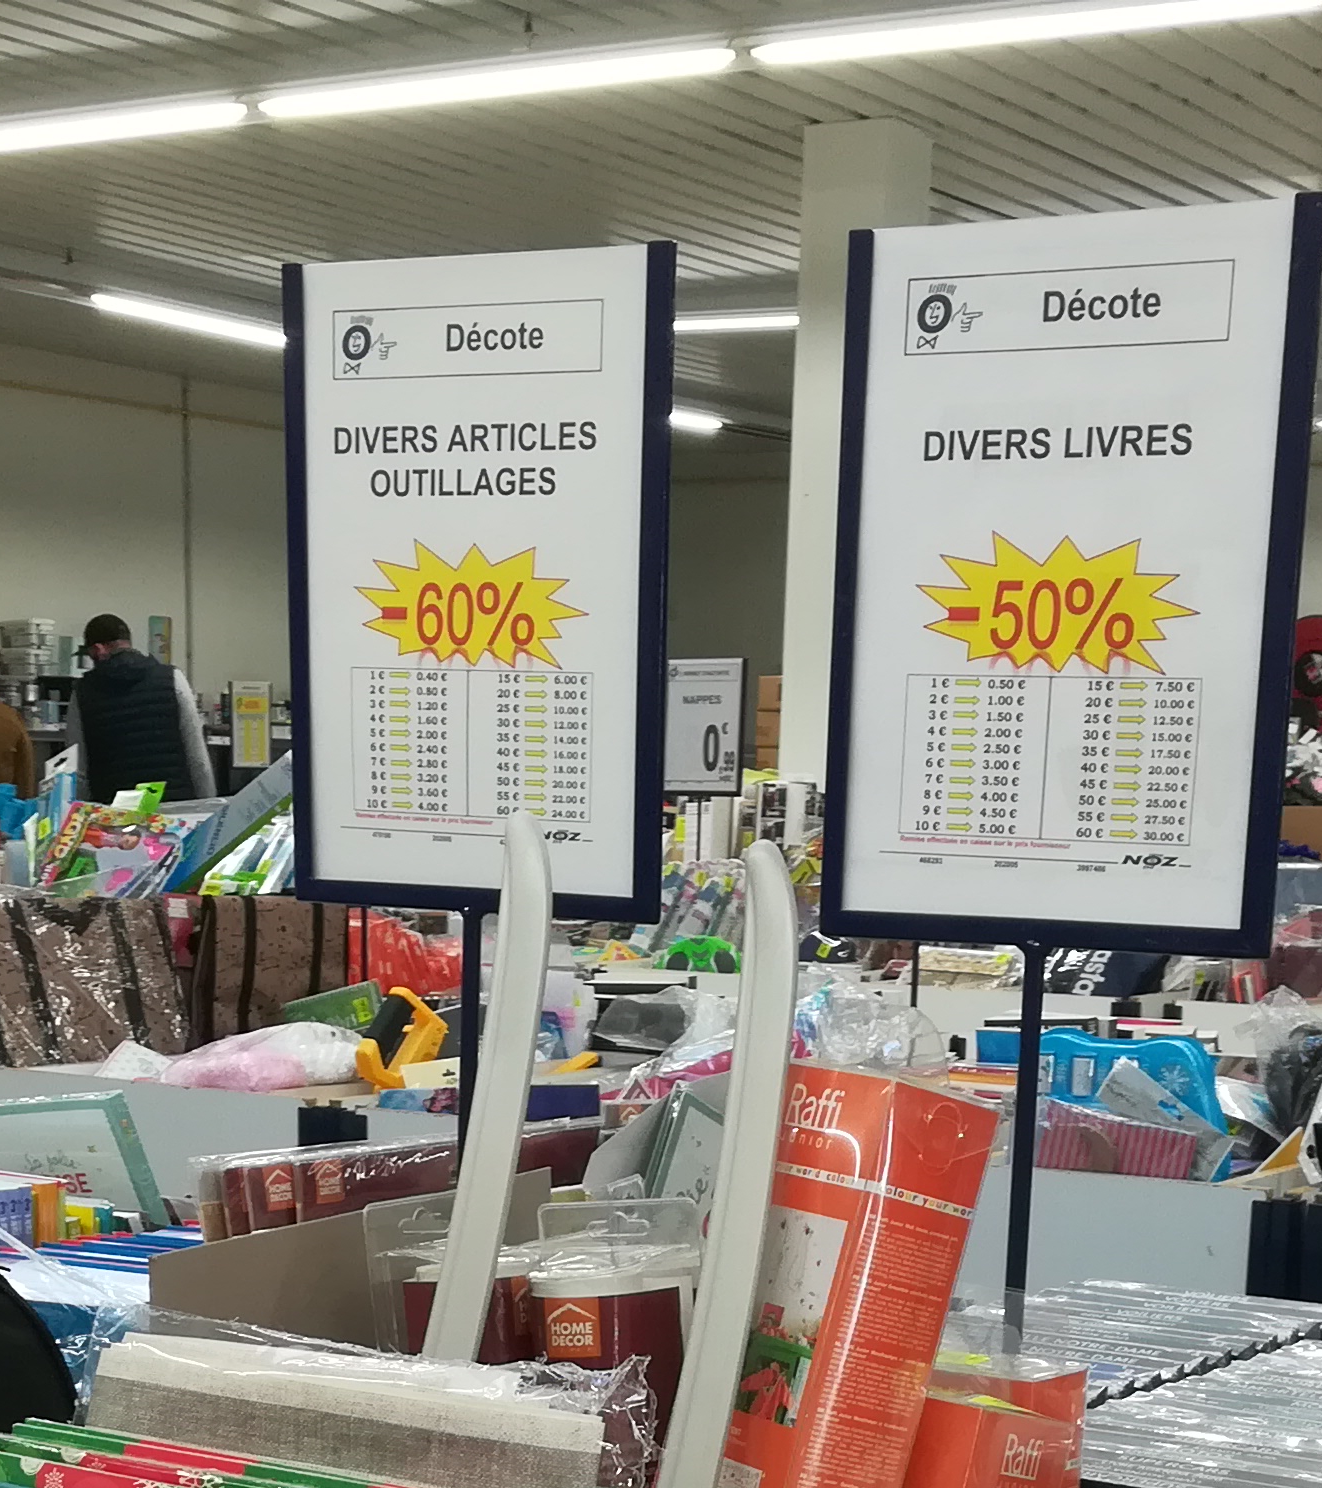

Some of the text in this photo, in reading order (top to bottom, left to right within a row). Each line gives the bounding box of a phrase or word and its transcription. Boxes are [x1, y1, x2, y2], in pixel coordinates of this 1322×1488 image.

[1042, 287, 1161, 322] Décote
[446, 322, 544, 352] Décote
[334, 421, 597, 454] DIVERS ARTICLES
[923, 424, 1193, 461] DIVERS LIVRES
[371, 467, 556, 497] OUTILLAGES
[382, 582, 535, 646] -60%
[949, 578, 1134, 650] -50%
[988, 680, 1182, 692] 0.50 15 7.50
[988, 696, 1184, 709] 1.00 20 10.00
[986, 712, 1183, 726] 1.50 25 12.50
[985, 728, 1182, 742] 2.00 15.00
[984, 744, 1180, 758] 2.50 17.50
[983, 760, 1179, 775] 3.00 20.00
[982, 776, 1178, 791] 3.50 22.50
[981, 792, 1177, 808] 4.00 25.00
[980, 808, 1175, 825] 4.50 27.50
[979, 824, 1174, 841] 5.00 30.00
[785, 1083, 847, 1130] Raffi
[551, 1322, 593, 1334] HOME
[552, 1335, 594, 1346] DECOR
[1001, 1434, 1044, 1480] Raffi
